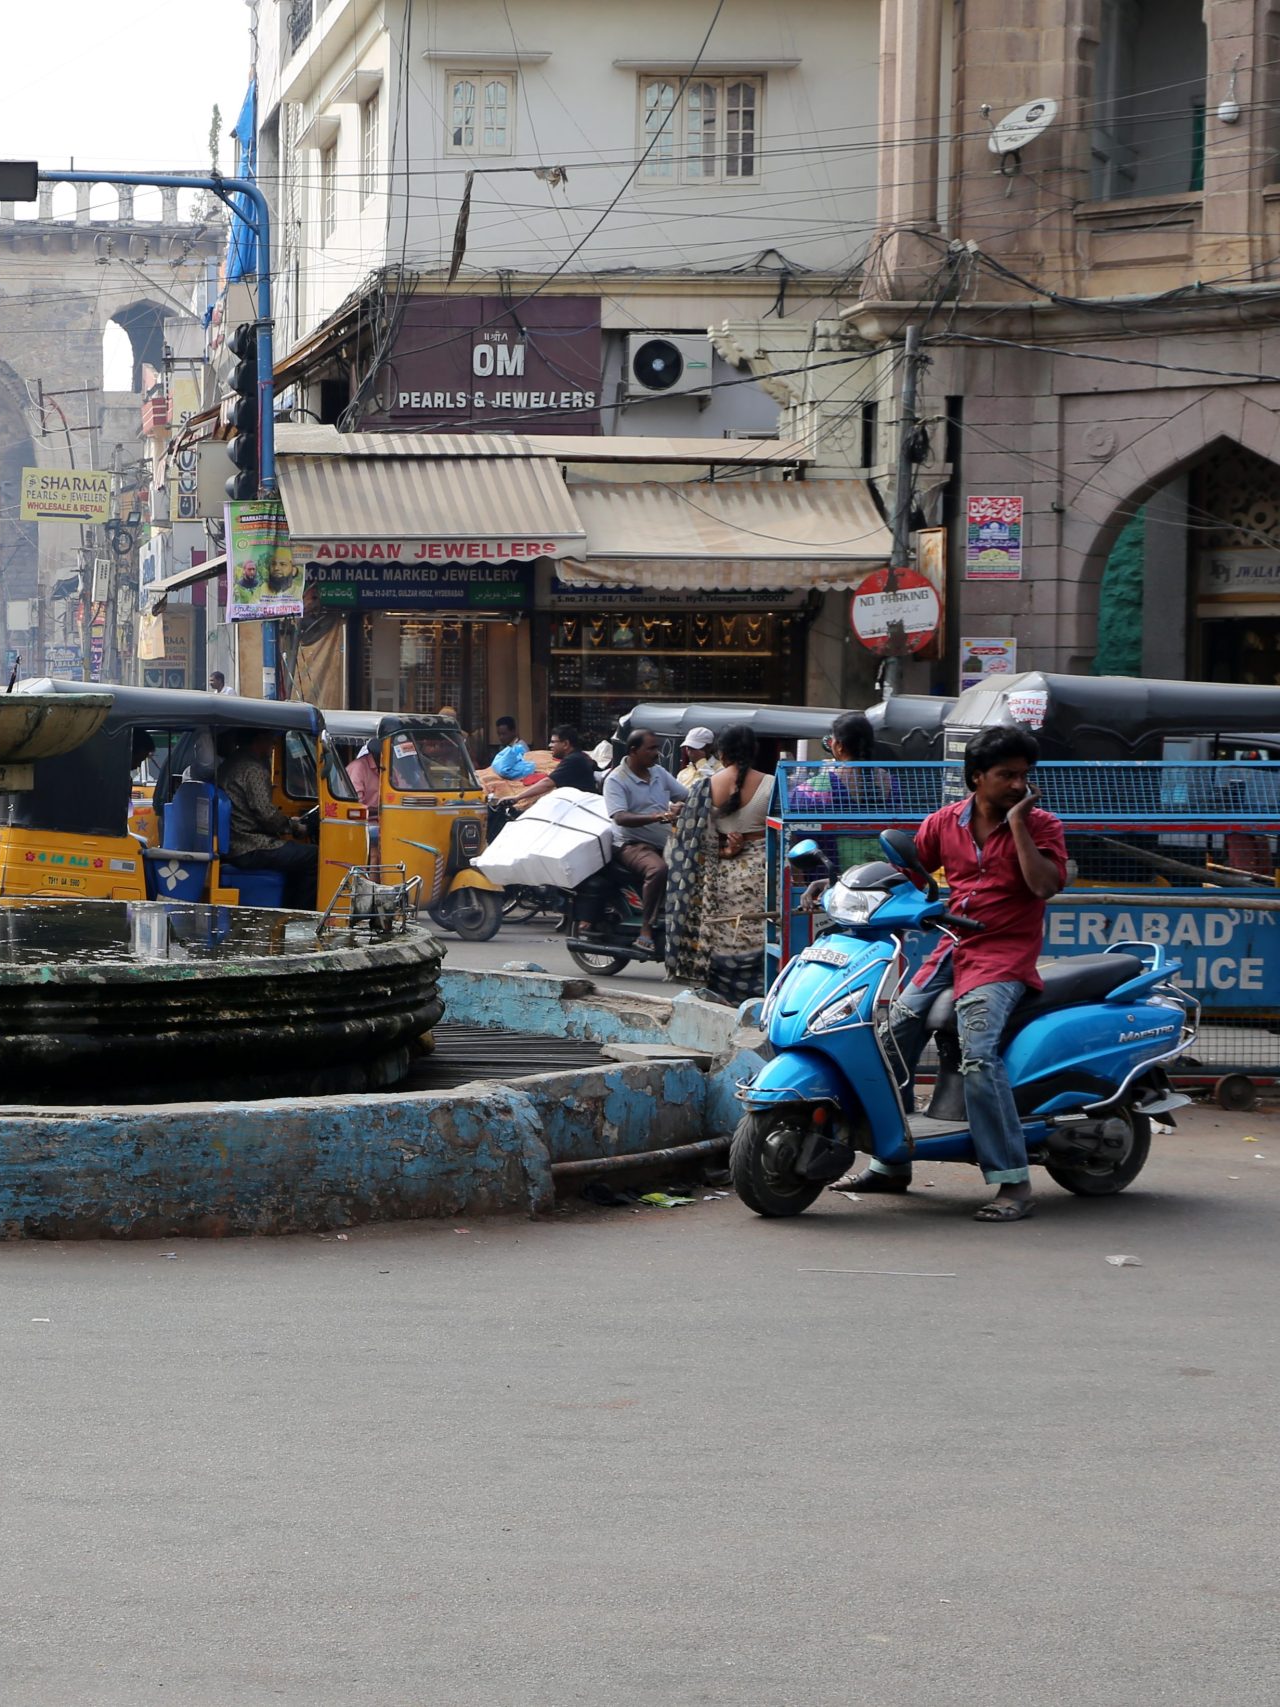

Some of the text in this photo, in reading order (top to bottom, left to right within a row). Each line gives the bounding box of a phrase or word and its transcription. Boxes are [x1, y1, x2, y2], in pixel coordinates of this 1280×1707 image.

[472, 343, 525, 377] OM
[399, 391, 596, 409] PEARLS & JEWELLERS
[40, 475, 108, 493] SHARMA
[26, 490, 58, 500] PEARLS
[69, 491, 107, 502] JEWELLERS
[26, 501, 105, 513] WHOLESALE & RETAIL
[414, 541, 559, 559] JEWELLERS
[346, 569, 379, 581] HALL
[383, 569, 438, 581] MARKED
[441, 569, 519, 581] JEWELLERY
[860, 590, 929, 607] NO PARKING
[1042, 912, 1234, 947] ERABAD
[1172, 957, 1265, 990] LICE
[1118, 1024, 1175, 1043] MAESTRO
